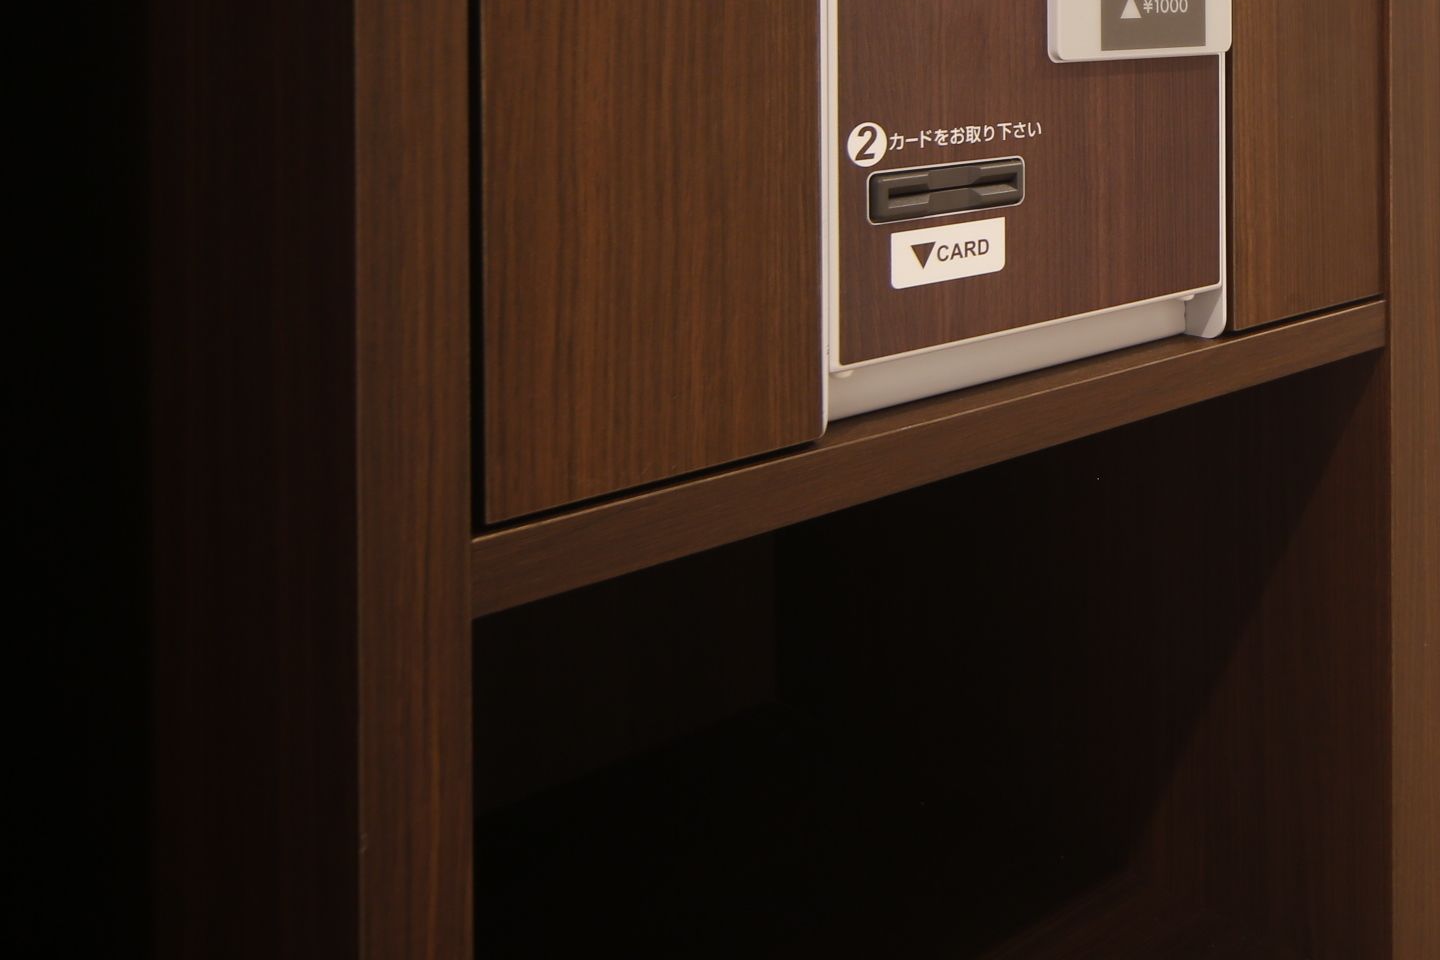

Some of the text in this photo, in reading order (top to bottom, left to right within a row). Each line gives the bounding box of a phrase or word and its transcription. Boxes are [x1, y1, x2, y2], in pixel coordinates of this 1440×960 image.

[888, 121, 1043, 152] カードをお取り下さい
[937, 238, 989, 262] CARD
